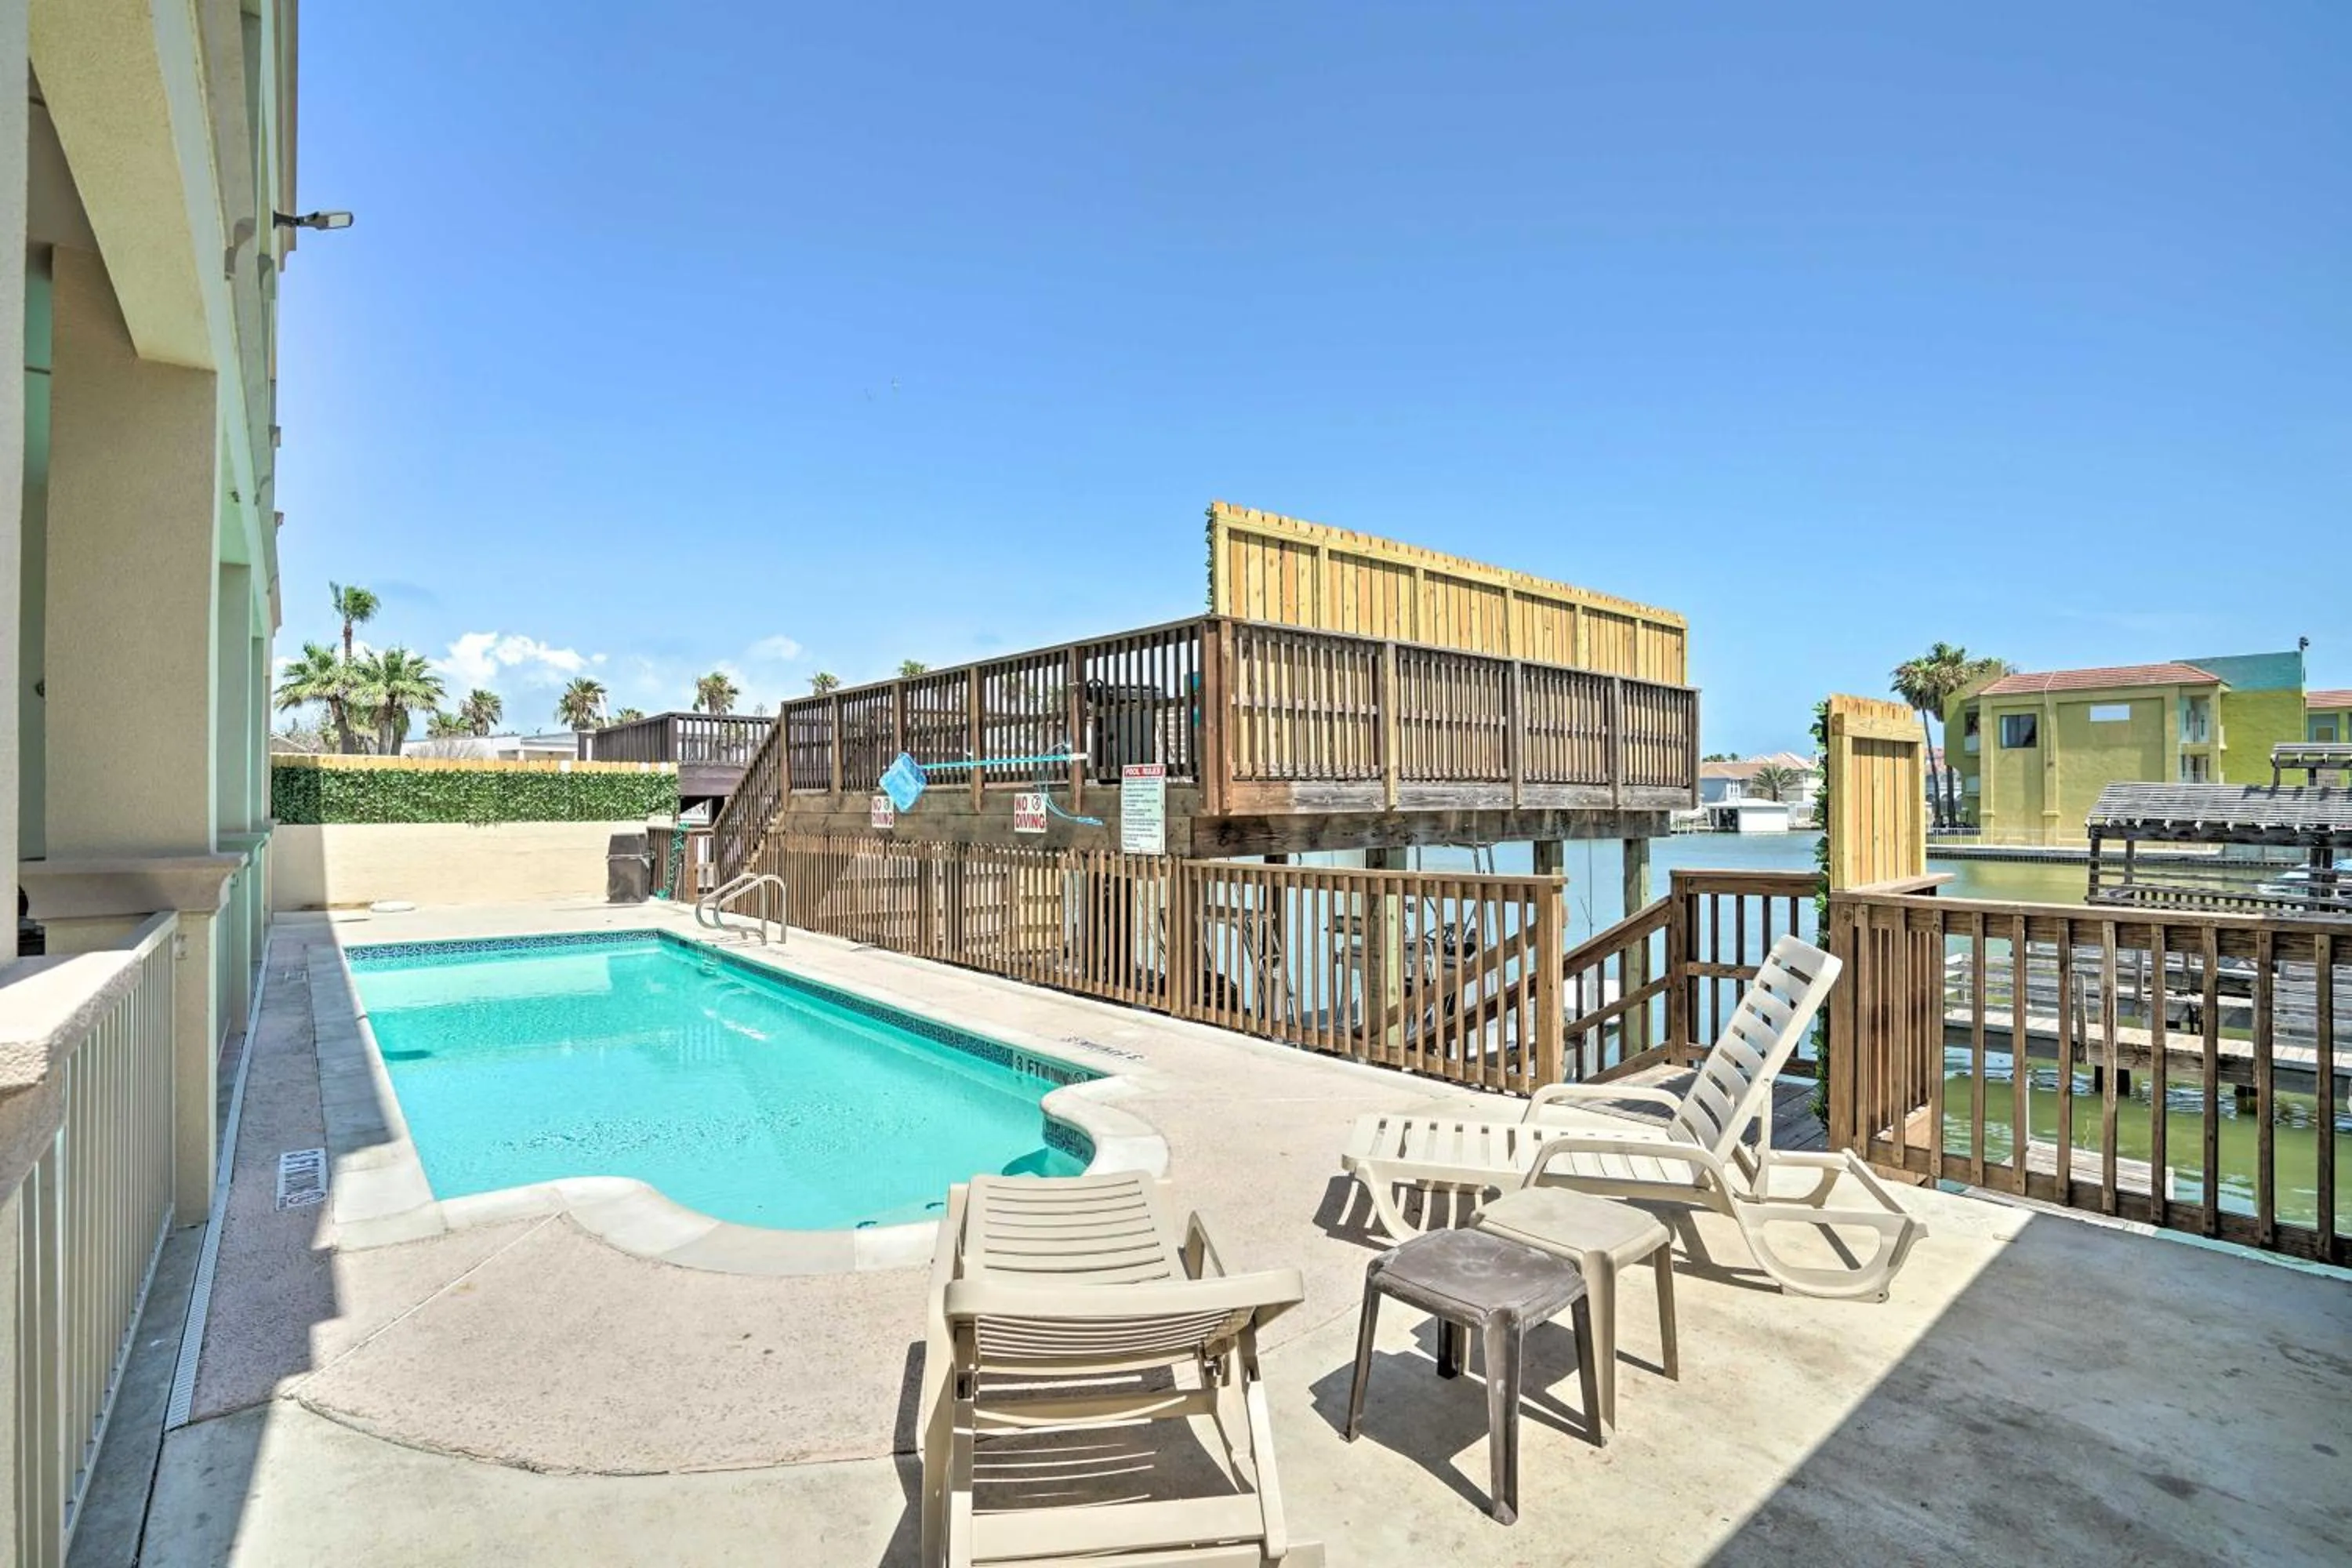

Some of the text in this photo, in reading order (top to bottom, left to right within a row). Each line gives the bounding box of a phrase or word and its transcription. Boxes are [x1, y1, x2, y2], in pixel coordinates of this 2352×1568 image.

[872, 798, 881, 811] NO
[1015, 796, 1028, 811] NO
[872, 811, 893, 826] DIVING
[1015, 813, 1045, 829] DIVING
[1016, 1054, 1023, 1073] 3
[1027, 1058, 1041, 1078] FT
